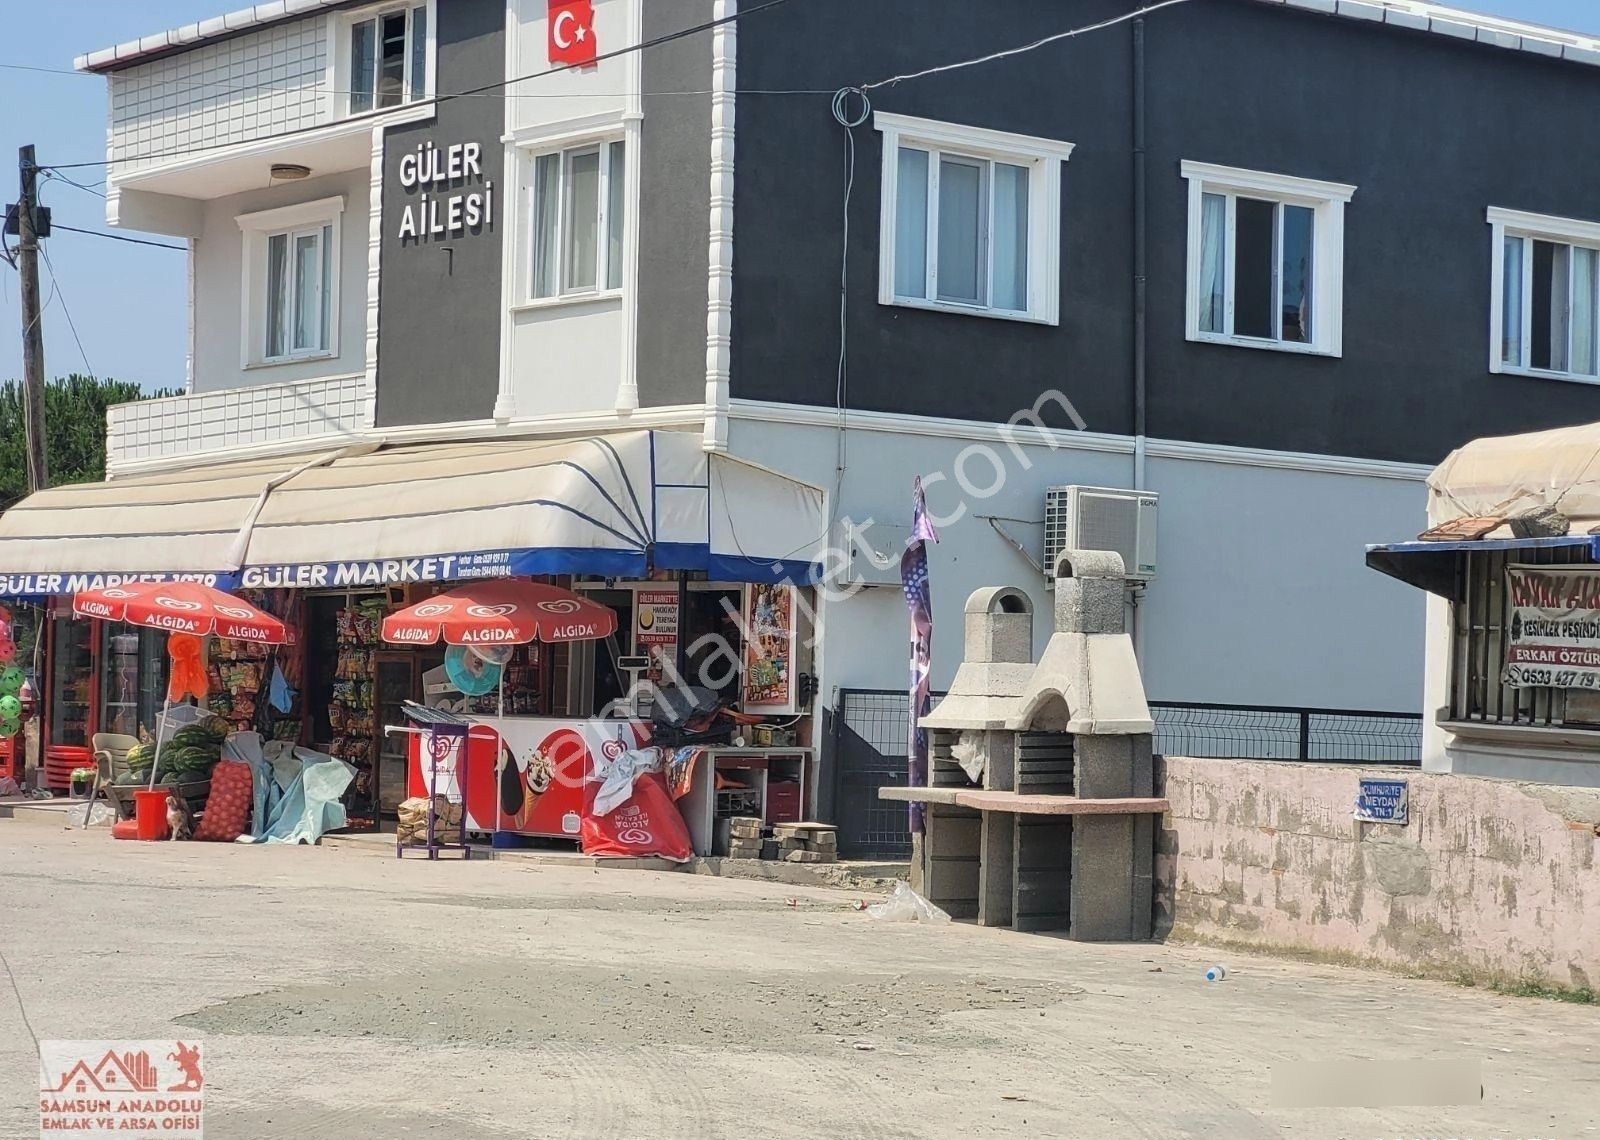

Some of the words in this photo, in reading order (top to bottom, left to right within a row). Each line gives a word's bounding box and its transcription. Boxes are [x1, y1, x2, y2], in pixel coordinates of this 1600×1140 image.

[400, 141, 480, 187] GÜLER
[399, 181, 491, 238] AİLESİ
[242, 564, 328, 587] GÜLER
[333, 555, 456, 585] MARKET
[1523, 616, 1559, 637] KESİMLER
[1516, 649, 1555, 661] ERKAN
[1522, 668, 1551, 683] 0533
[1555, 671, 1577, 685] 427
